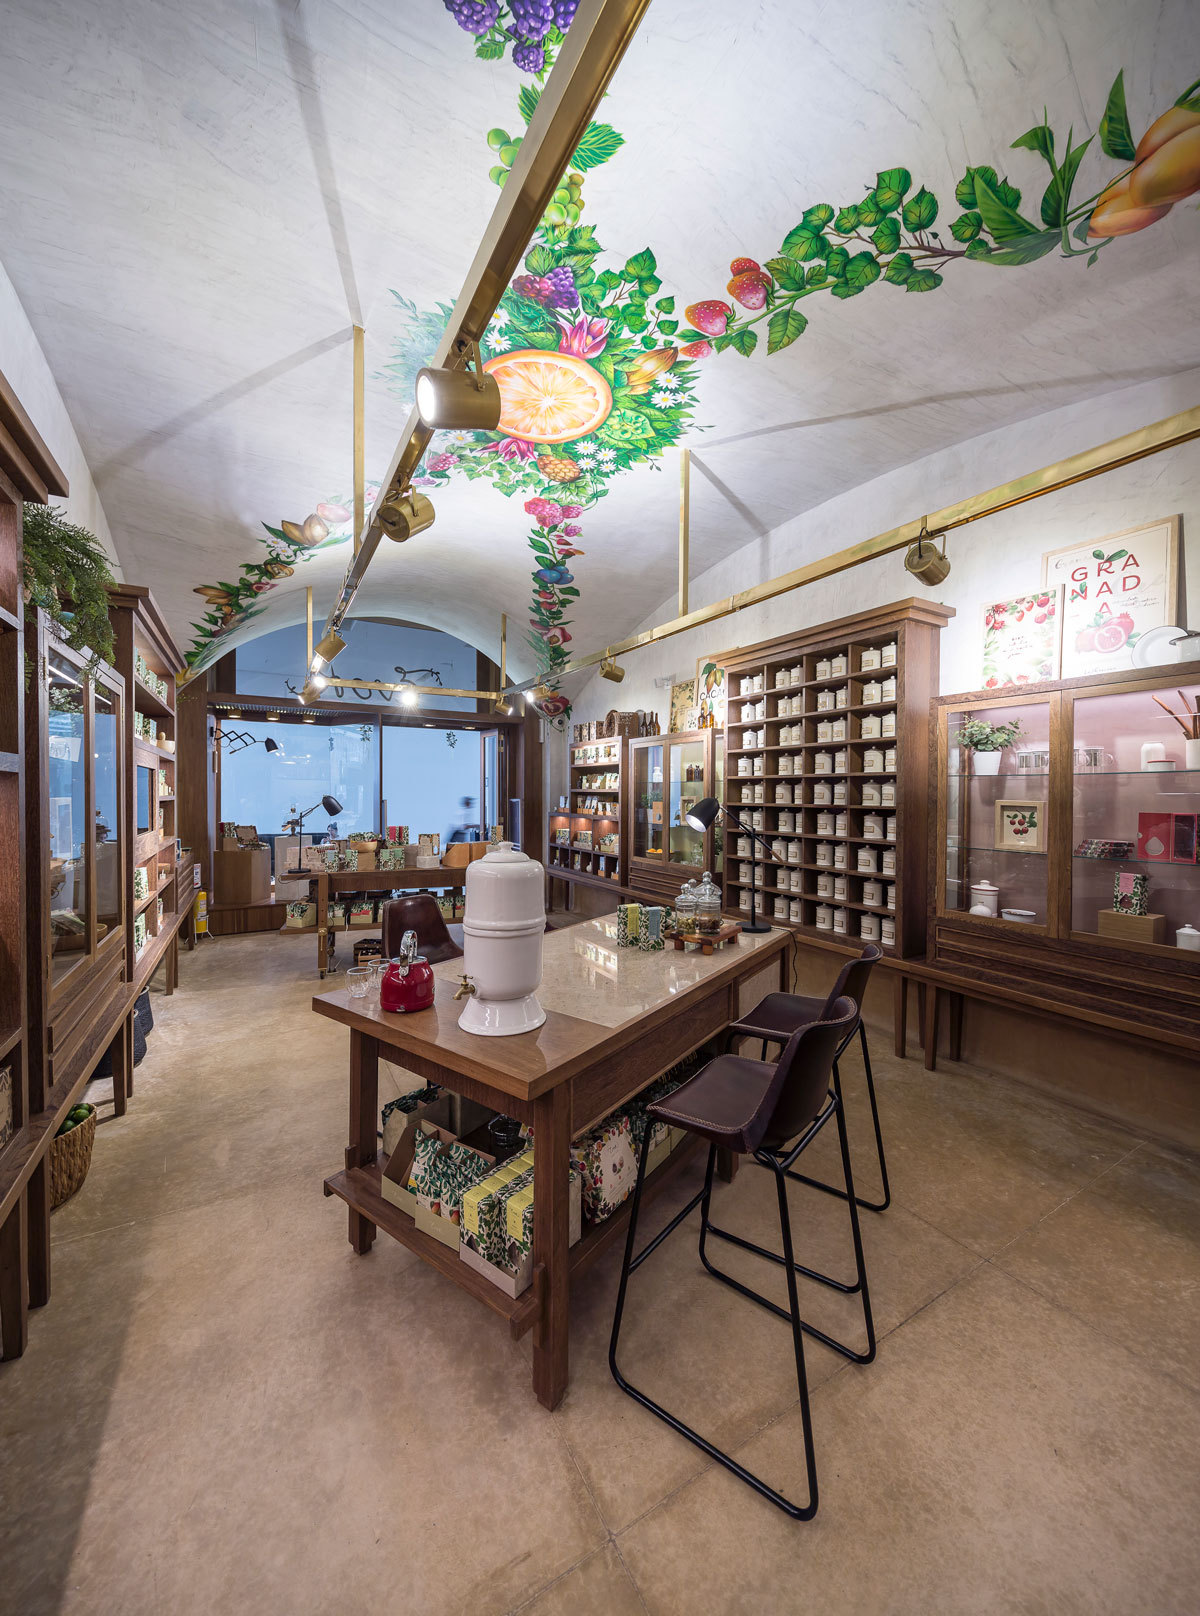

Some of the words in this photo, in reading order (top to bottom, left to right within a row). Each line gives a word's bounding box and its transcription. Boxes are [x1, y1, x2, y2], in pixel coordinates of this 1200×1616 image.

[1071, 554, 1140, 582] GRA
[1071, 575, 1141, 603] NAD
[700, 688, 725, 701] CACA
